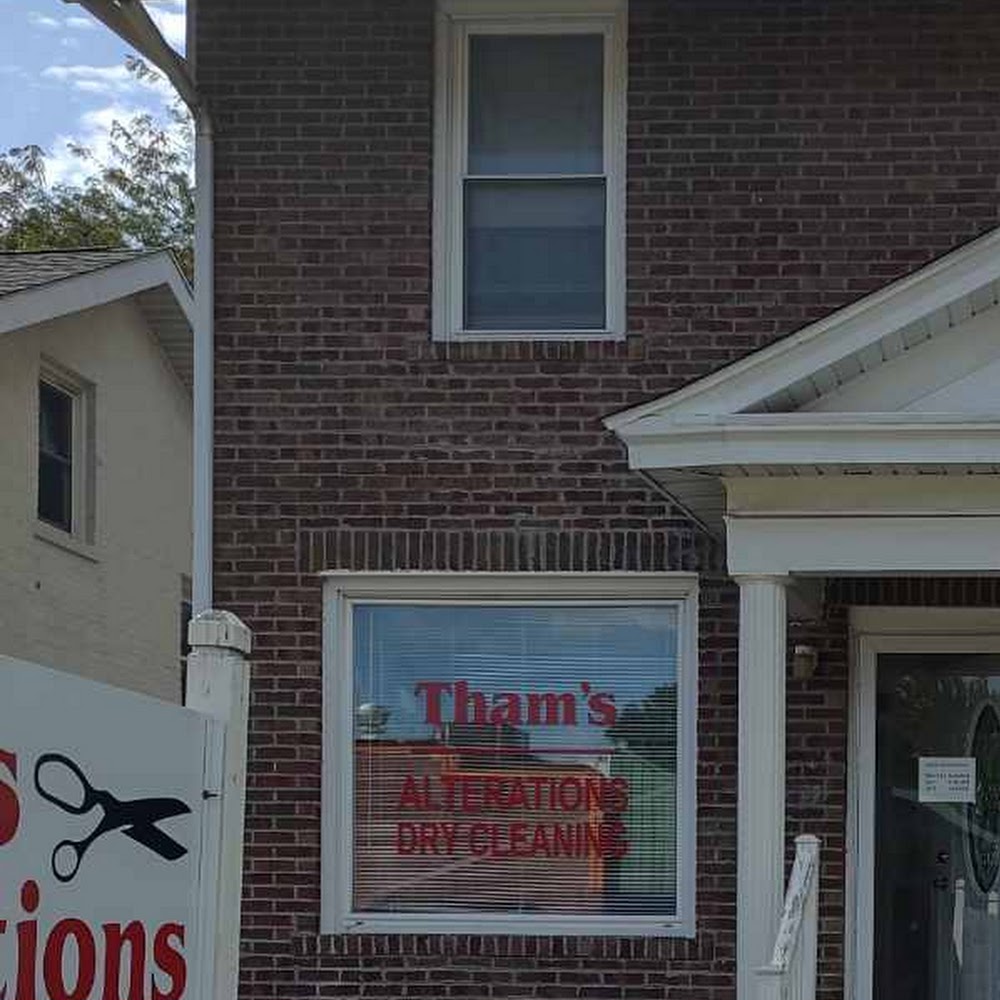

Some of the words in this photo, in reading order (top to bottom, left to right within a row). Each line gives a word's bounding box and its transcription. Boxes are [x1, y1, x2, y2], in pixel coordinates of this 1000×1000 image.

[414, 680, 617, 728] Tham's
[398, 774, 630, 814] ALTERATIONS
[396, 821, 455, 856] DRY
[469, 822, 632, 861] CLEANING
